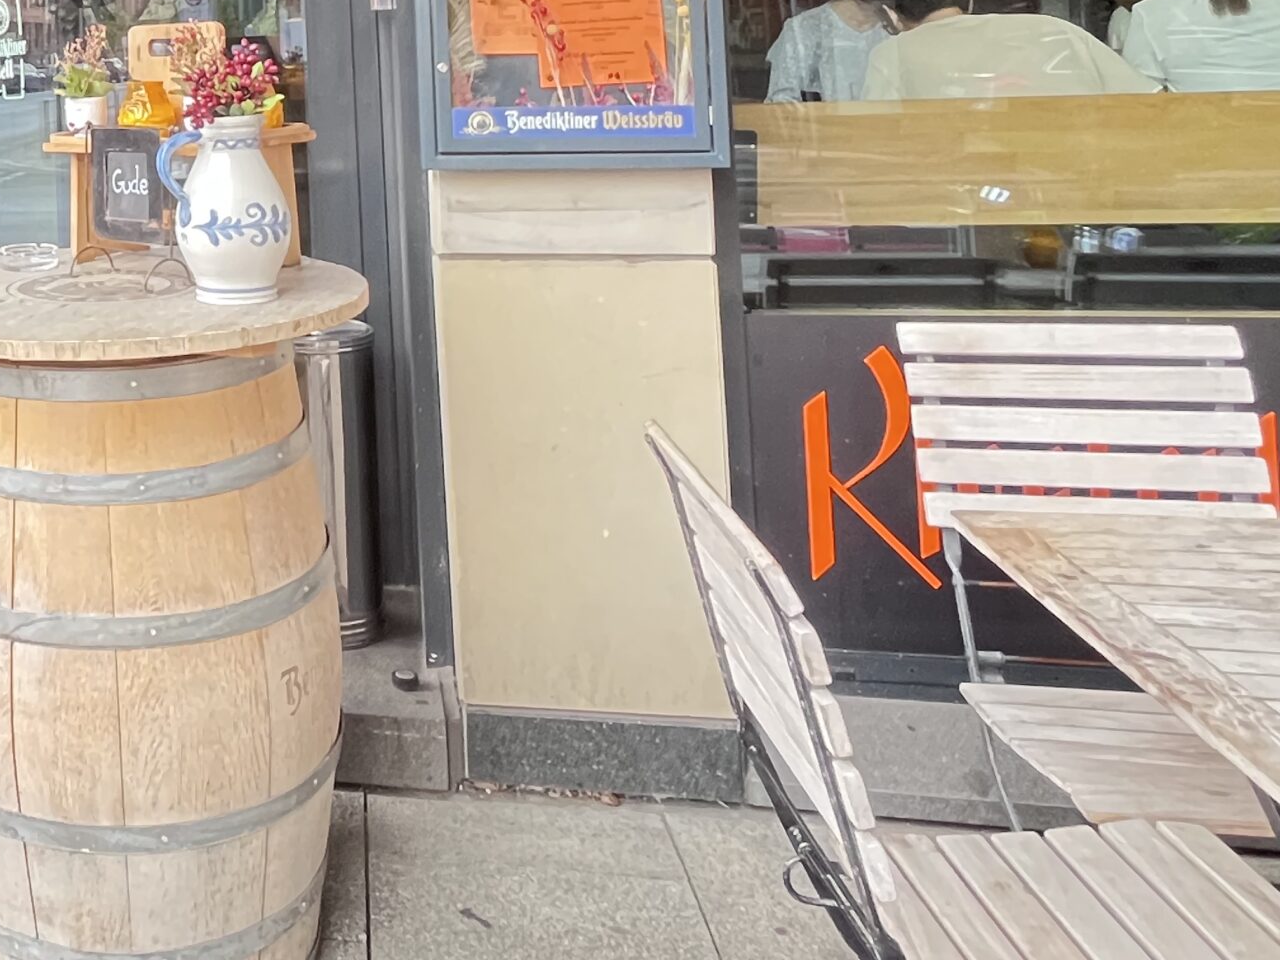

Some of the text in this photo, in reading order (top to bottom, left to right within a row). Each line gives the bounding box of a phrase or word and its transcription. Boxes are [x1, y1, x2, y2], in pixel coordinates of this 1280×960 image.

[504, 110, 683, 133] Benediktiner Weissbräu
[112, 164, 149, 195] Gude
